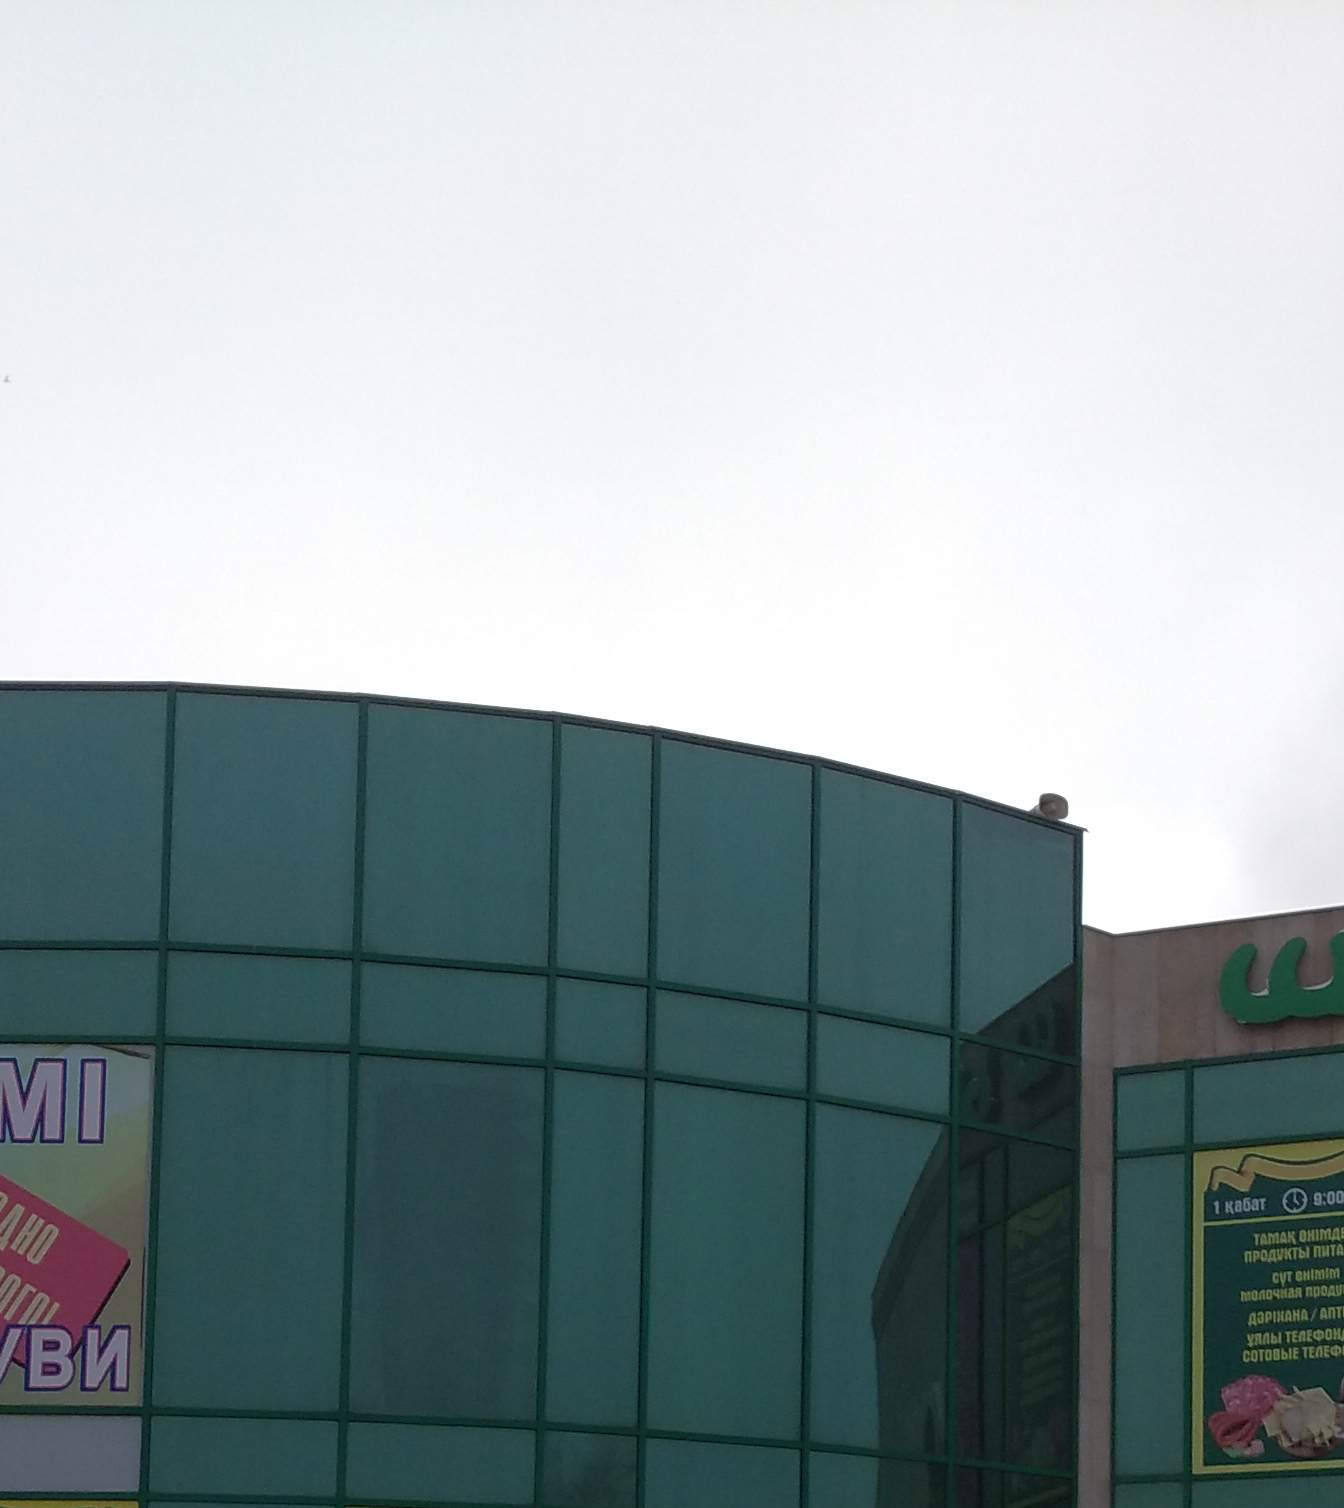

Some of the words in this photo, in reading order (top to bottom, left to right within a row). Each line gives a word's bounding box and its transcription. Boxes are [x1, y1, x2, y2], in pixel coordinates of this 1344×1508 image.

[1213, 1201, 1220, 1215] 1
[1313, 1190, 1344, 1206] 9:00
[1254, 1230, 1296, 1246] ТАМАҚ
[1244, 1245, 1310, 1263] ПРОДУКТЫ
[1240, 1287, 1302, 1302] МОЛОЧНАЯ
[1242, 1347, 1299, 1363] СОТОВЫЕ
